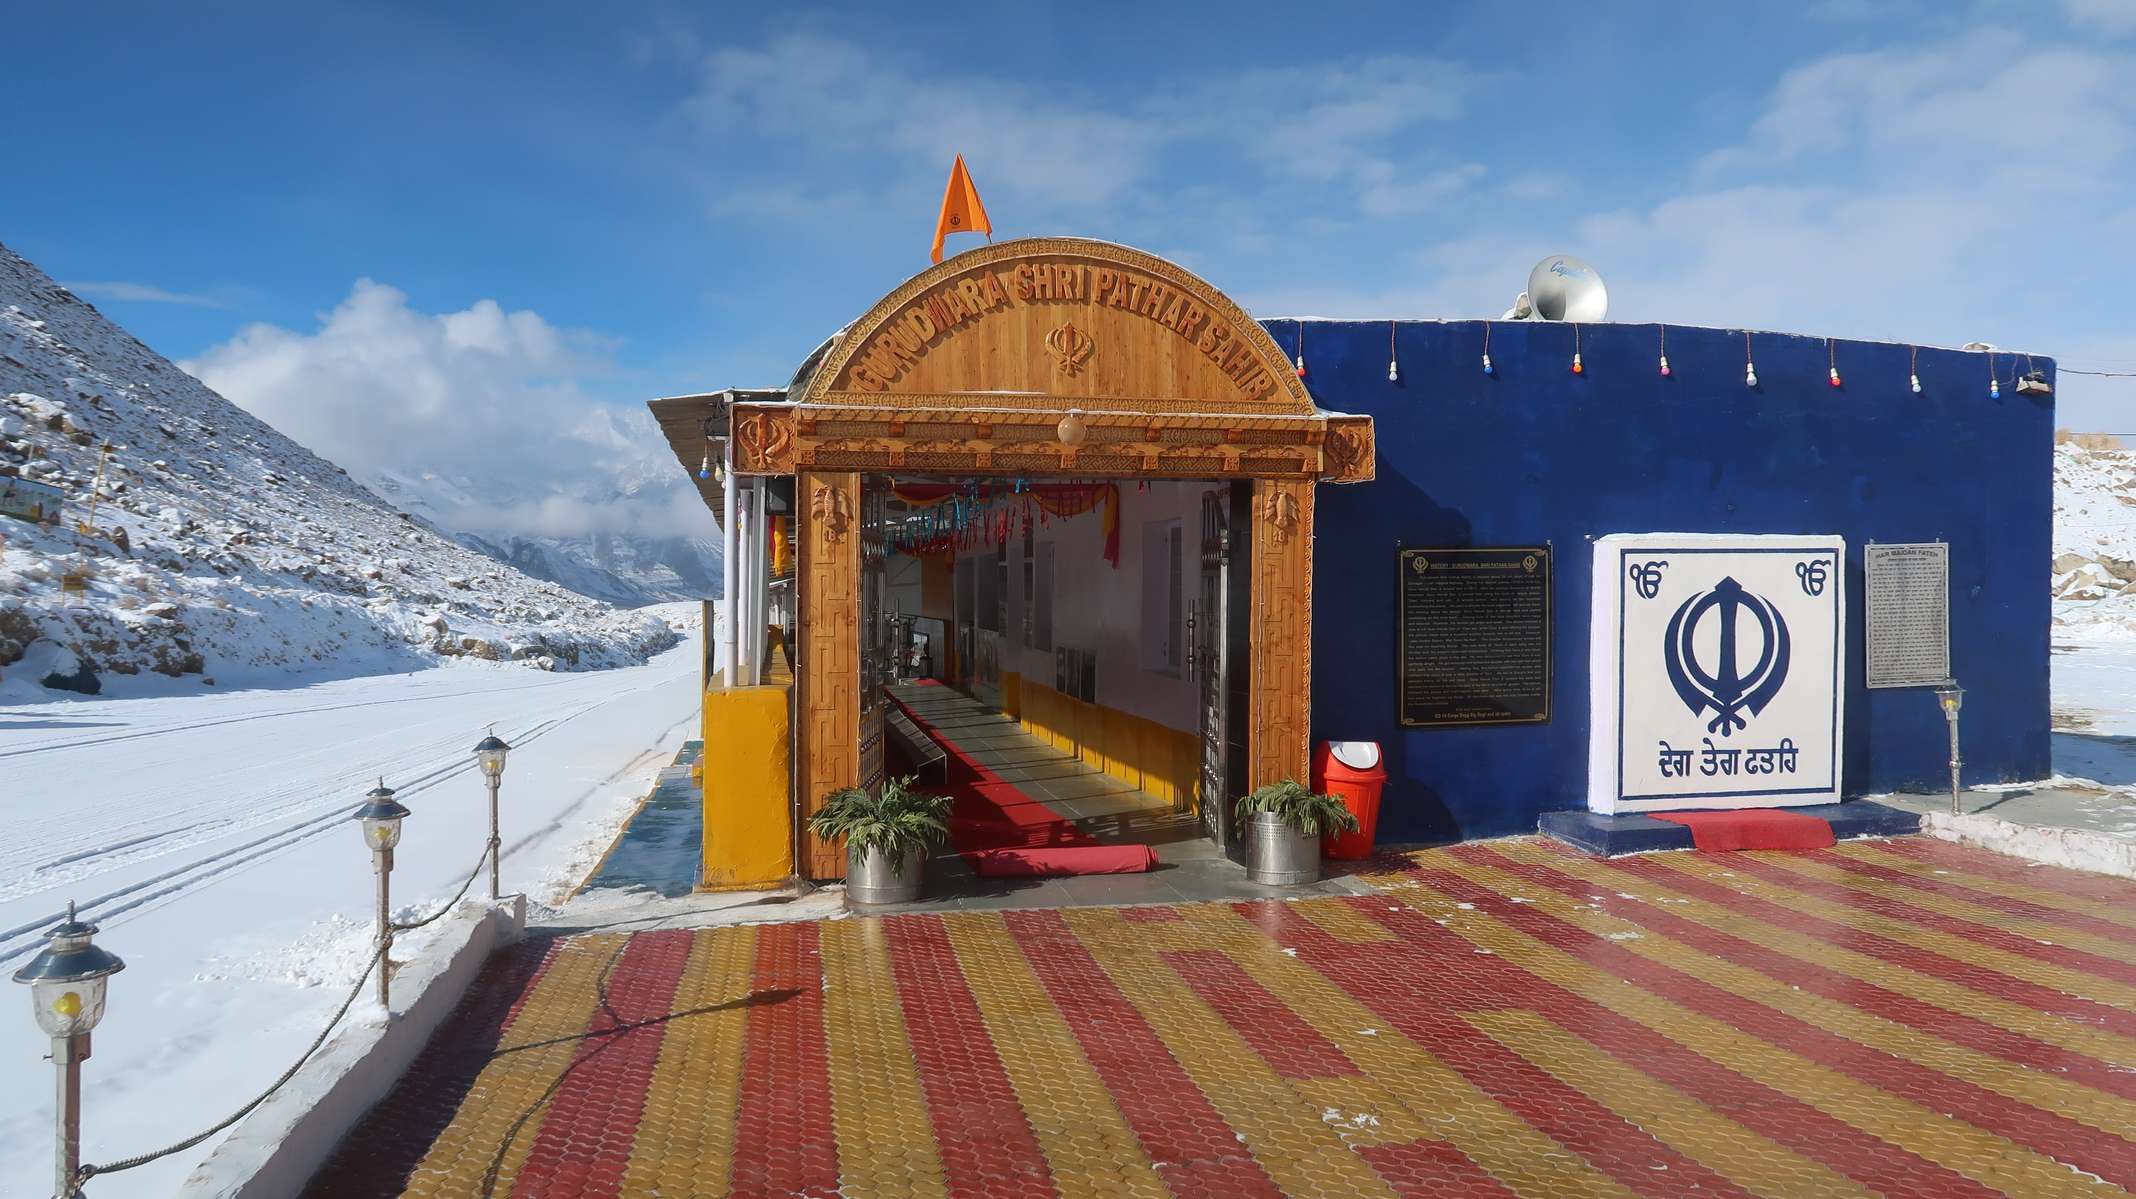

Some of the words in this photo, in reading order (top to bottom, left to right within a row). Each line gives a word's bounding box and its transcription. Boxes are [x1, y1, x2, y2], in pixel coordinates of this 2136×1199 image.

[850, 270, 1010, 393] GURUDWARA
[1015, 263, 1085, 300] SHRI
[1093, 270, 1205, 342] PATHAR
[1199, 319, 1276, 398] SAHIB
[1658, 740, 1694, 777] ਦੇਗ
[1699, 737, 1741, 776] ਤੇਗ
